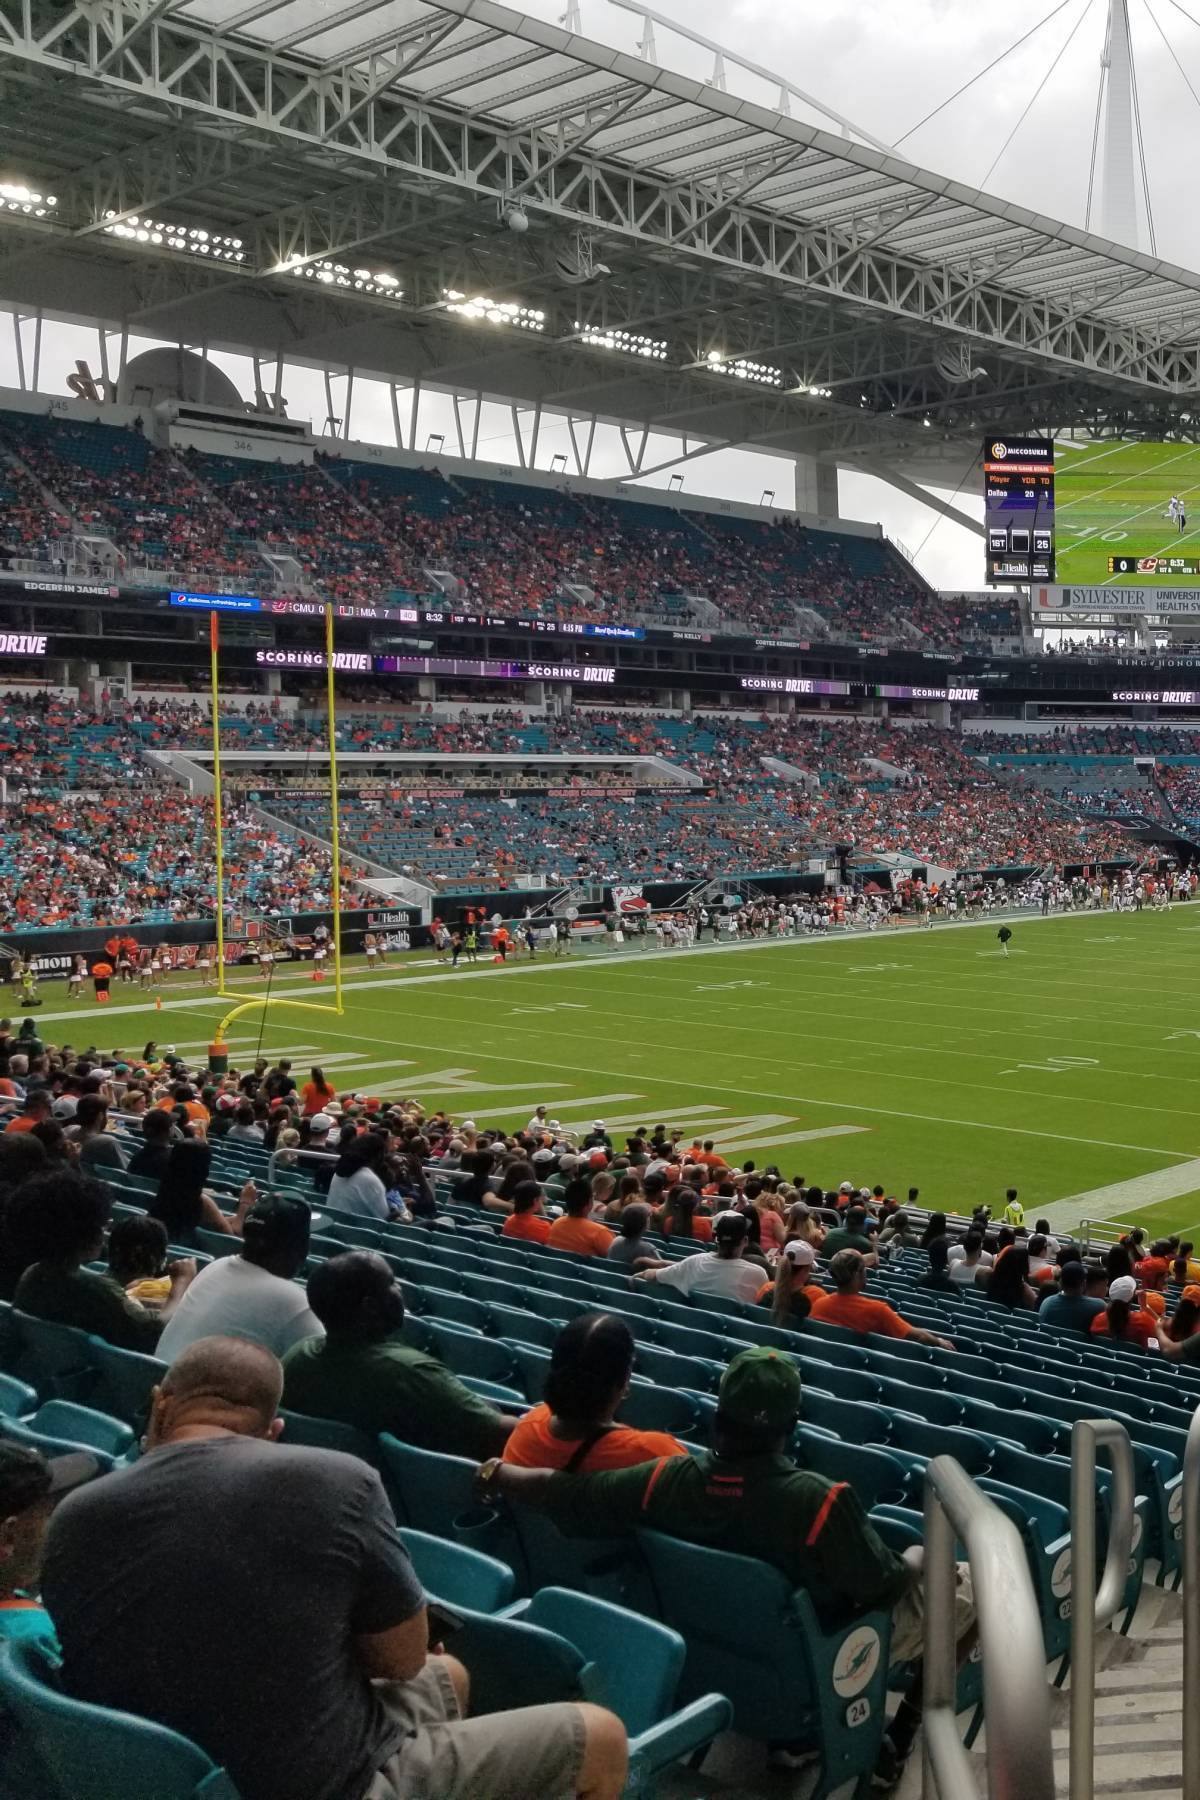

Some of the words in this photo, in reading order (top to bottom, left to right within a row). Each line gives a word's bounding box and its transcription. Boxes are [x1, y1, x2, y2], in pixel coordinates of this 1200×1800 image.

[235, 440, 252, 451] 346
[1025, 490, 1035, 498] 20
[1037, 540, 1048, 549] 25
[1120, 561, 1127, 571] 0
[1170, 559, 1184, 567] 8:32
[77, 586, 109, 596] JAMES
[1072, 589, 1145, 605] SYLVESTER
[293, 603, 314, 613] CMU
[318, 605, 324, 613] 0
[1156, 602, 1189, 611] HEALTH
[360, 608, 377, 618] MIA
[384, 610, 390, 618] 7
[425, 613, 443, 622] 8:32
[684, 633, 702, 641] KELLY
[256, 651, 323, 664] SCORING
[528, 667, 580, 678] SCORING
[583, 667, 616, 682] DRIVE
[741, 679, 783, 689] SCORING
[785, 679, 811, 692] DRIVE
[912, 688, 946, 698] SCORING
[948, 688, 980, 701] DRIVE
[1112, 692, 1159, 701] SCORING
[1162, 691, 1192, 703] DRIVE
[851, 1702, 867, 1723] 24
